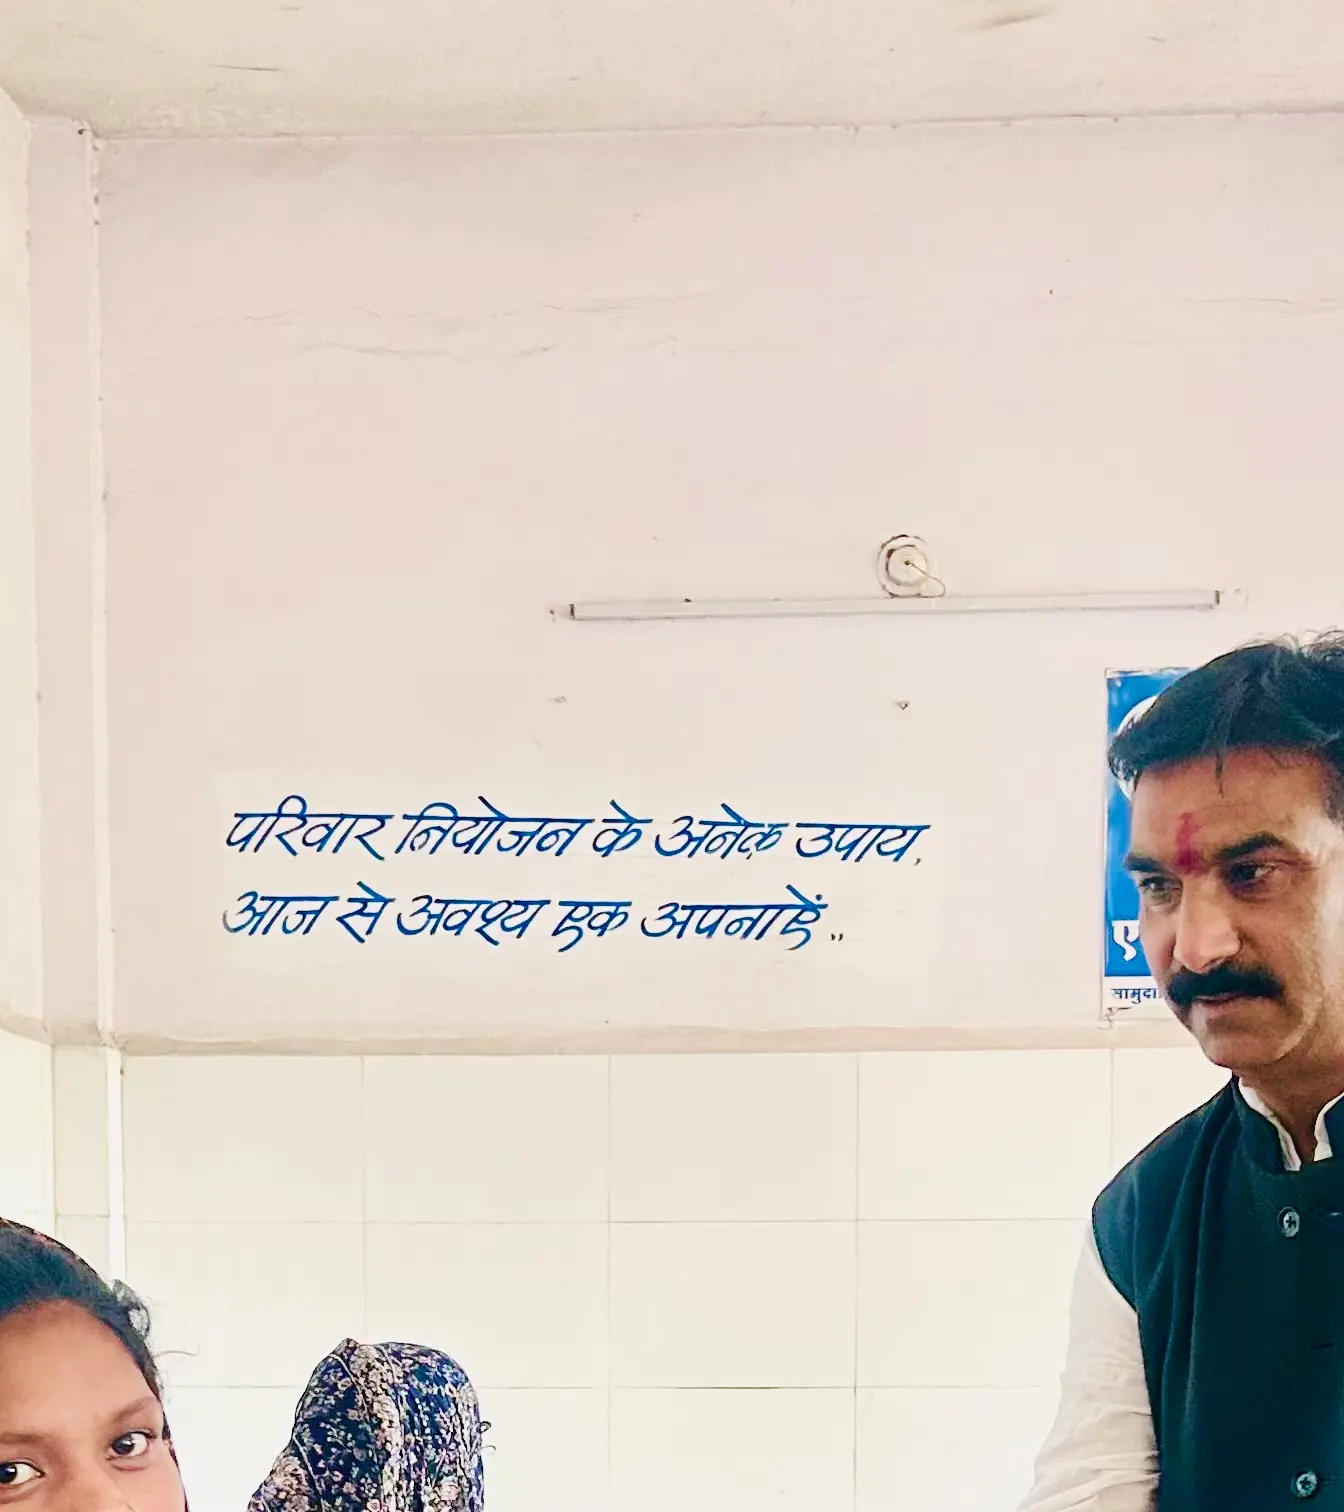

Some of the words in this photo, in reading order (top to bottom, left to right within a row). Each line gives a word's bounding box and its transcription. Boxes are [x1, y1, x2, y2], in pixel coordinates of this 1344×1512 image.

[226, 795, 394, 860] परिवार
[395, 796, 595, 857] नियोजन
[592, 799, 653, 857] के
[655, 803, 789, 860] अनेक
[222, 890, 340, 936] आज
[336, 880, 395, 943] से
[397, 894, 551, 945] अवश्य
[552, 900, 632, 952] एक
